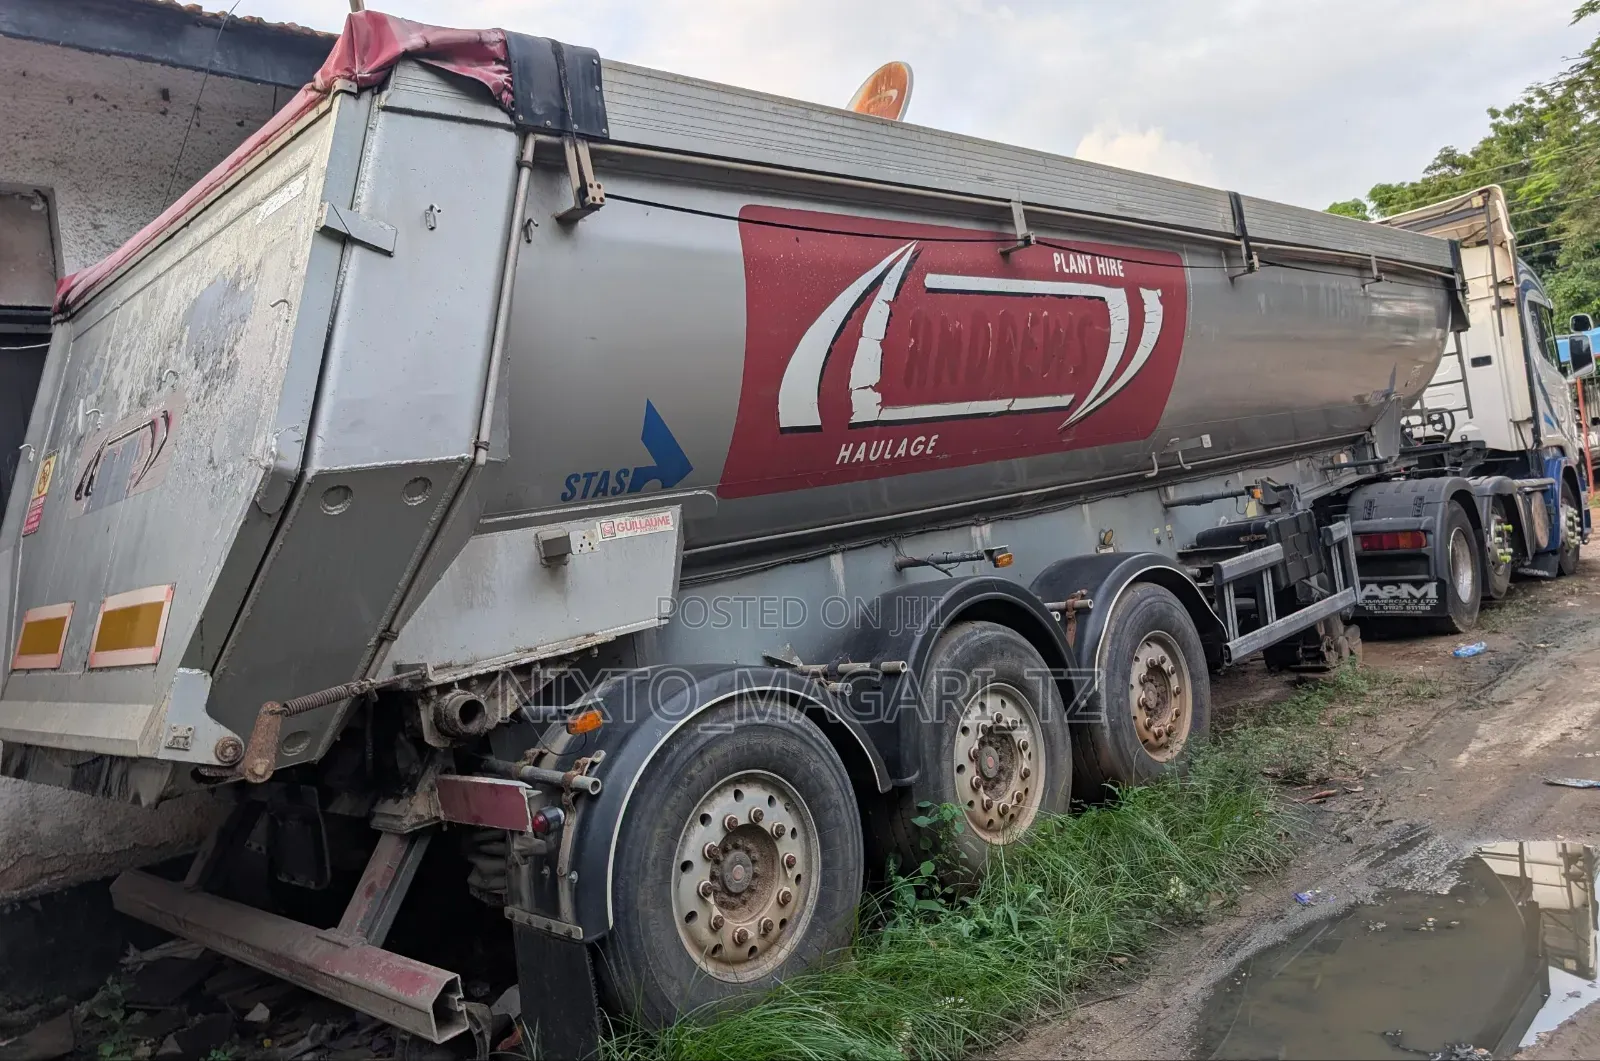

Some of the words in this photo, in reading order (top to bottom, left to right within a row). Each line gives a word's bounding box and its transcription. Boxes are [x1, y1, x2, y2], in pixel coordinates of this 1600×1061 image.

[1053, 252, 1092, 274] PLANT
[1096, 256, 1124, 277] HIRE
[836, 434, 939, 465] HAULAGE
[560, 468, 630, 502] STAS
[616, 515, 671, 533] GUILLAUME
[1359, 582, 1439, 599] A&M
